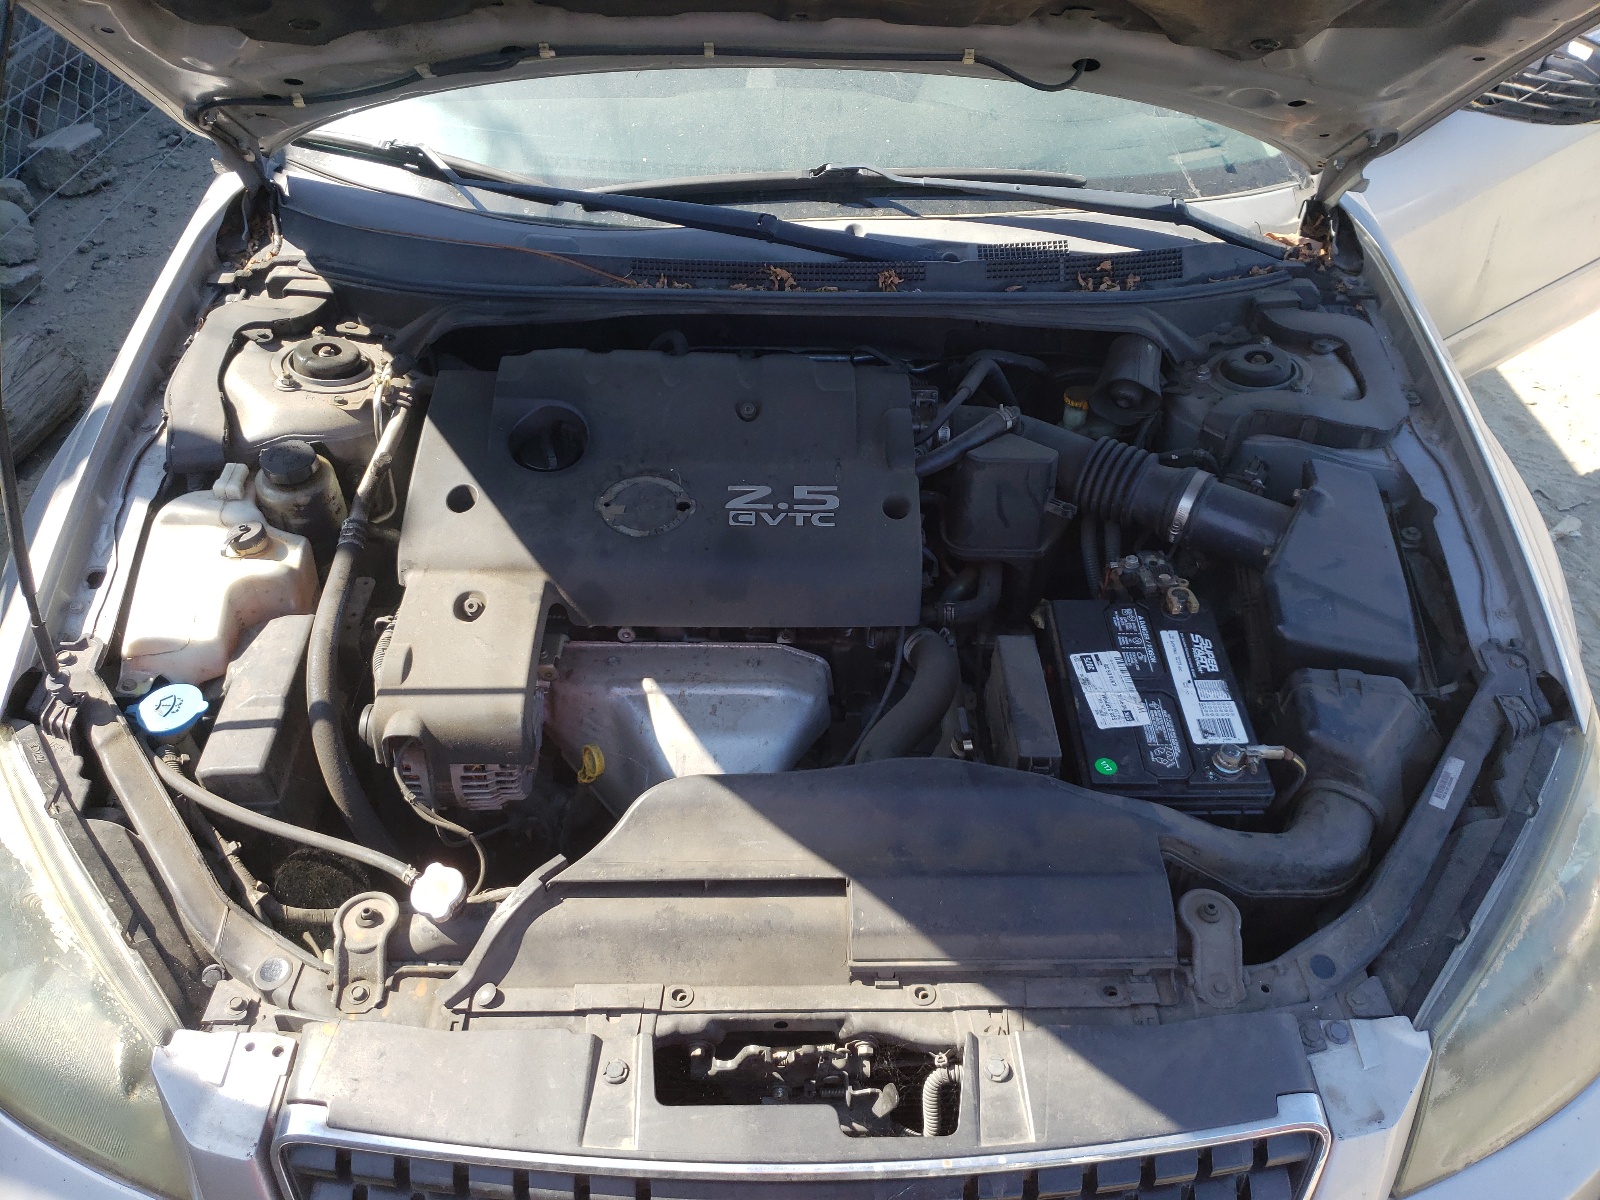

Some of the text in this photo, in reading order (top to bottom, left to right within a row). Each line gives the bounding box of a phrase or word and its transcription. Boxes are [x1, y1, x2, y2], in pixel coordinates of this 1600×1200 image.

[725, 485, 840, 510] 2.5
[1190, 633, 1207, 668] START
[1202, 637, 1219, 672] SUPER
